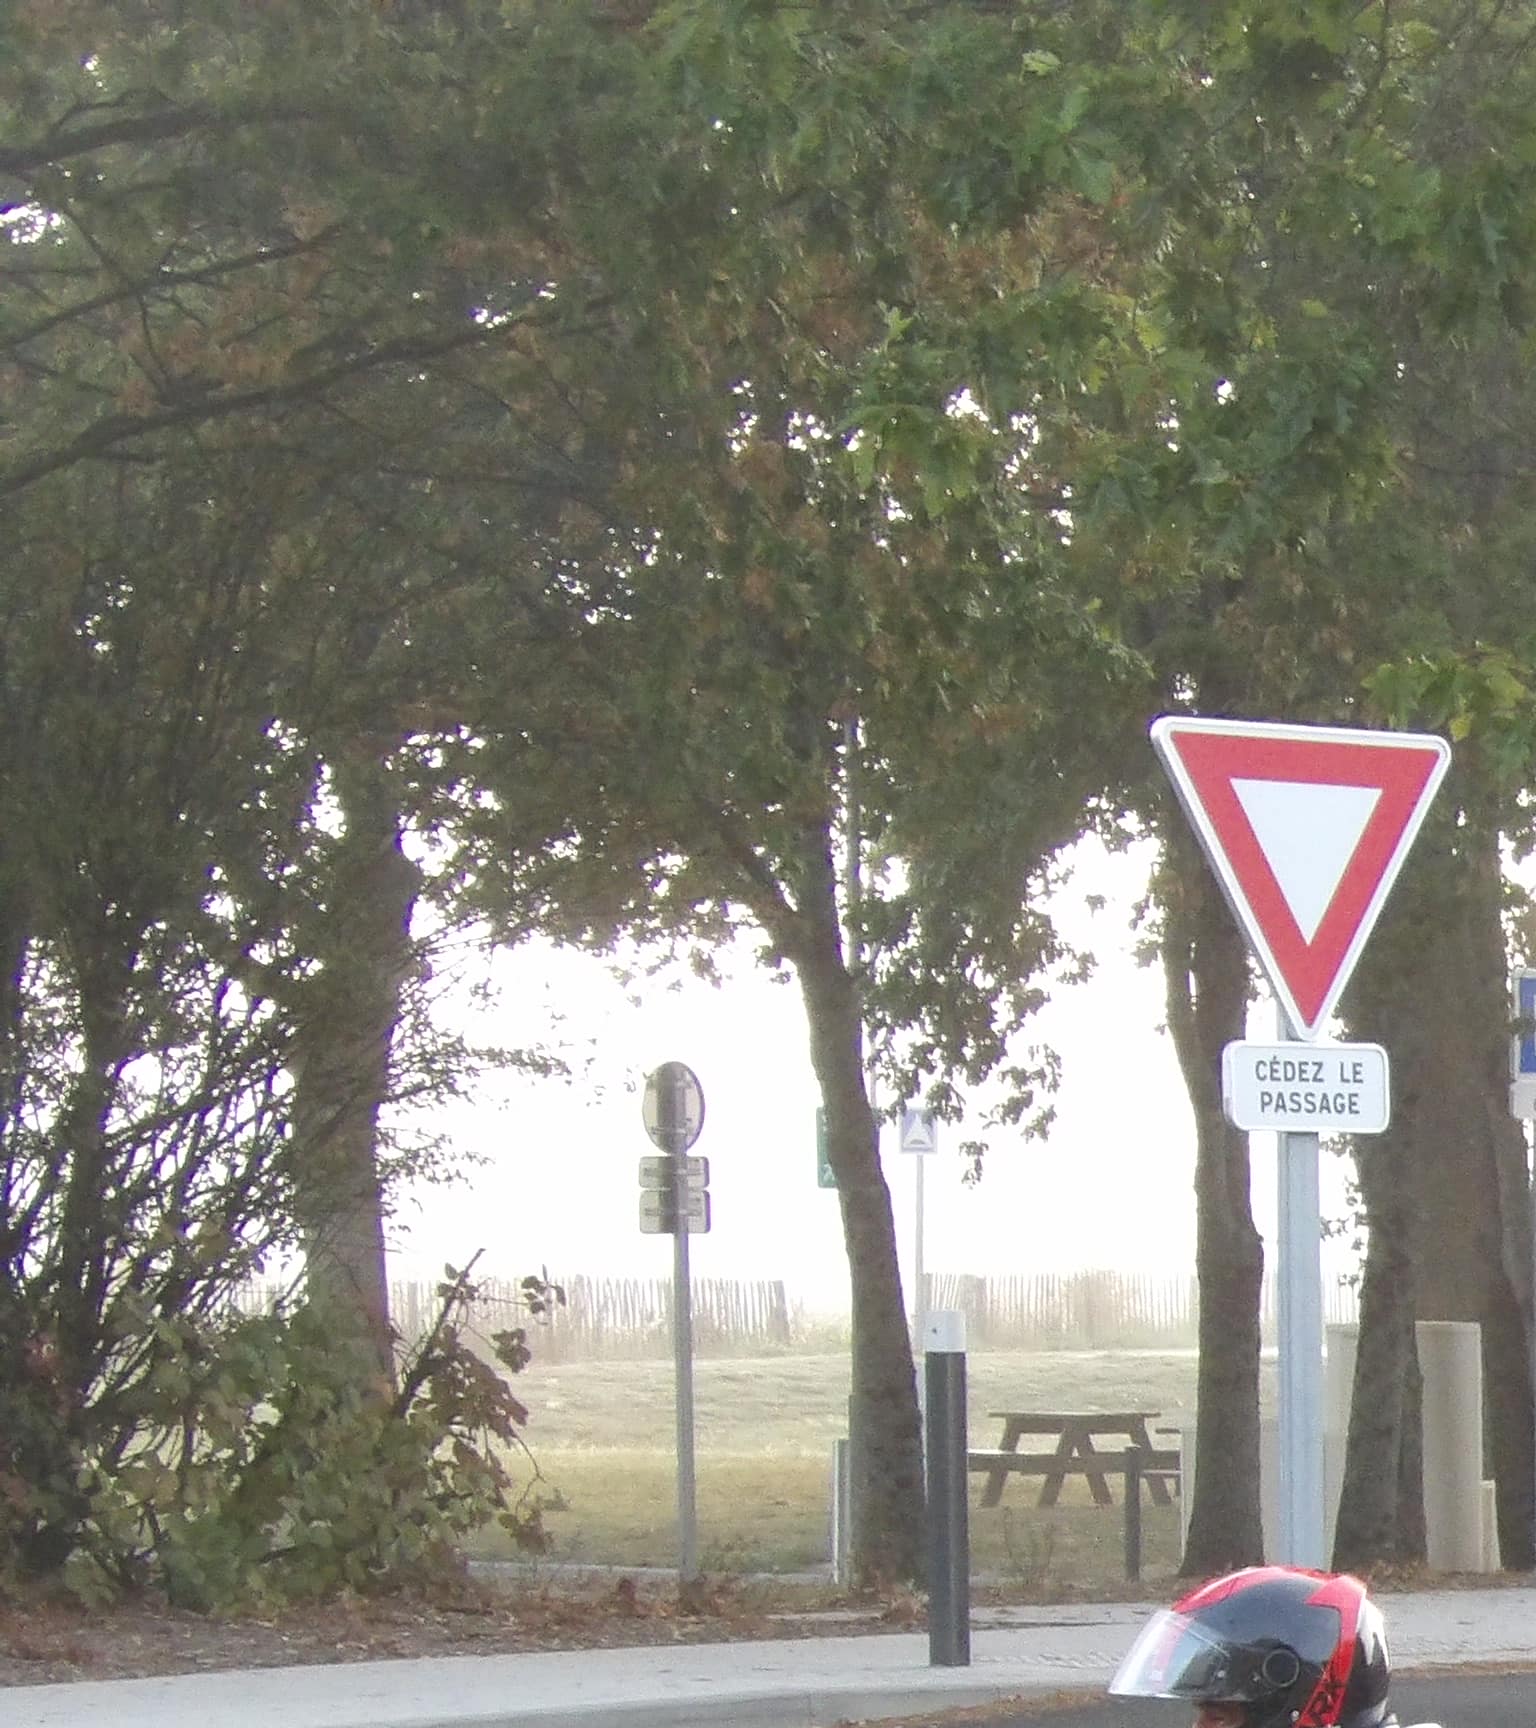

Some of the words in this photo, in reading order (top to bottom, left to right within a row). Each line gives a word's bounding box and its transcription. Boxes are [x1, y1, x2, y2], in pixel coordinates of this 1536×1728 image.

[1255, 1055, 1325, 1083] CÉDEZ
[1340, 1061, 1364, 1084] LE
[1260, 1091, 1361, 1115] PASSAGE
